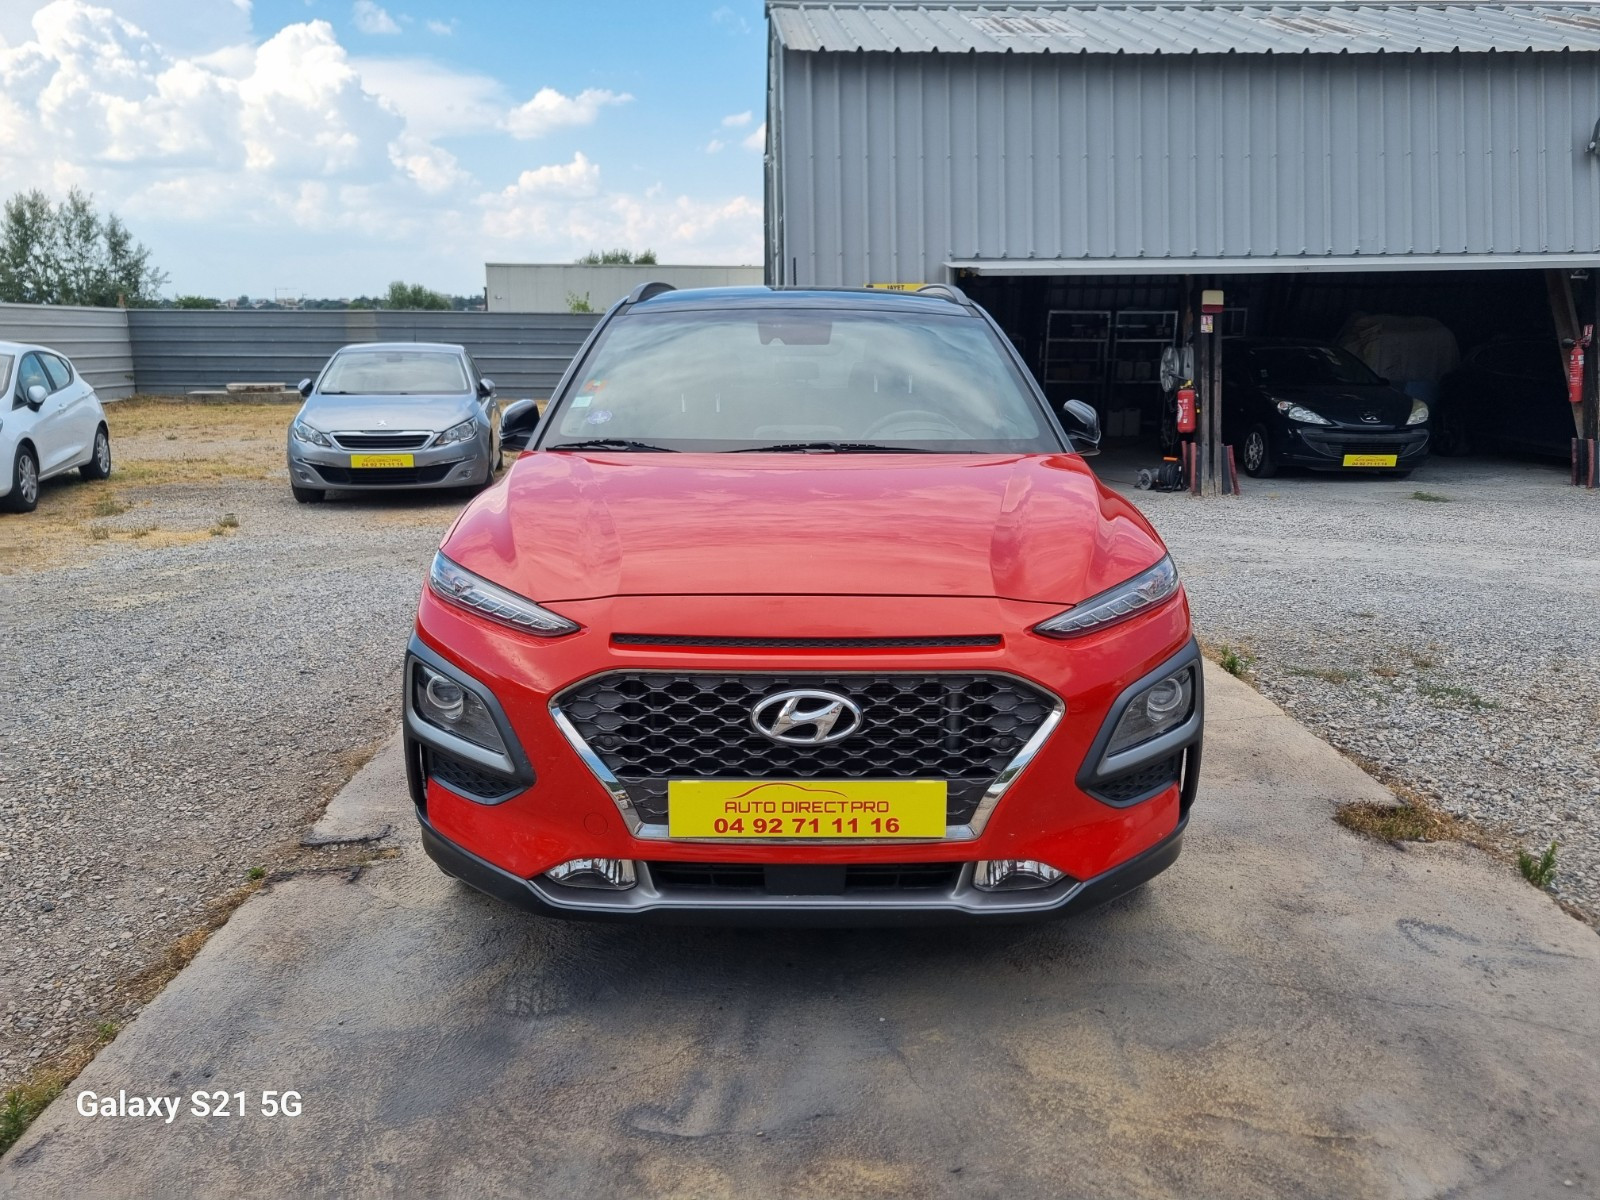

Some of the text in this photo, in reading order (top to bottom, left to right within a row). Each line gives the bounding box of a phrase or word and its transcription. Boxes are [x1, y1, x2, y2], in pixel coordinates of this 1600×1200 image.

[724, 801, 776, 814] AUTO
[713, 817, 900, 834] 04 92 71 11 16
